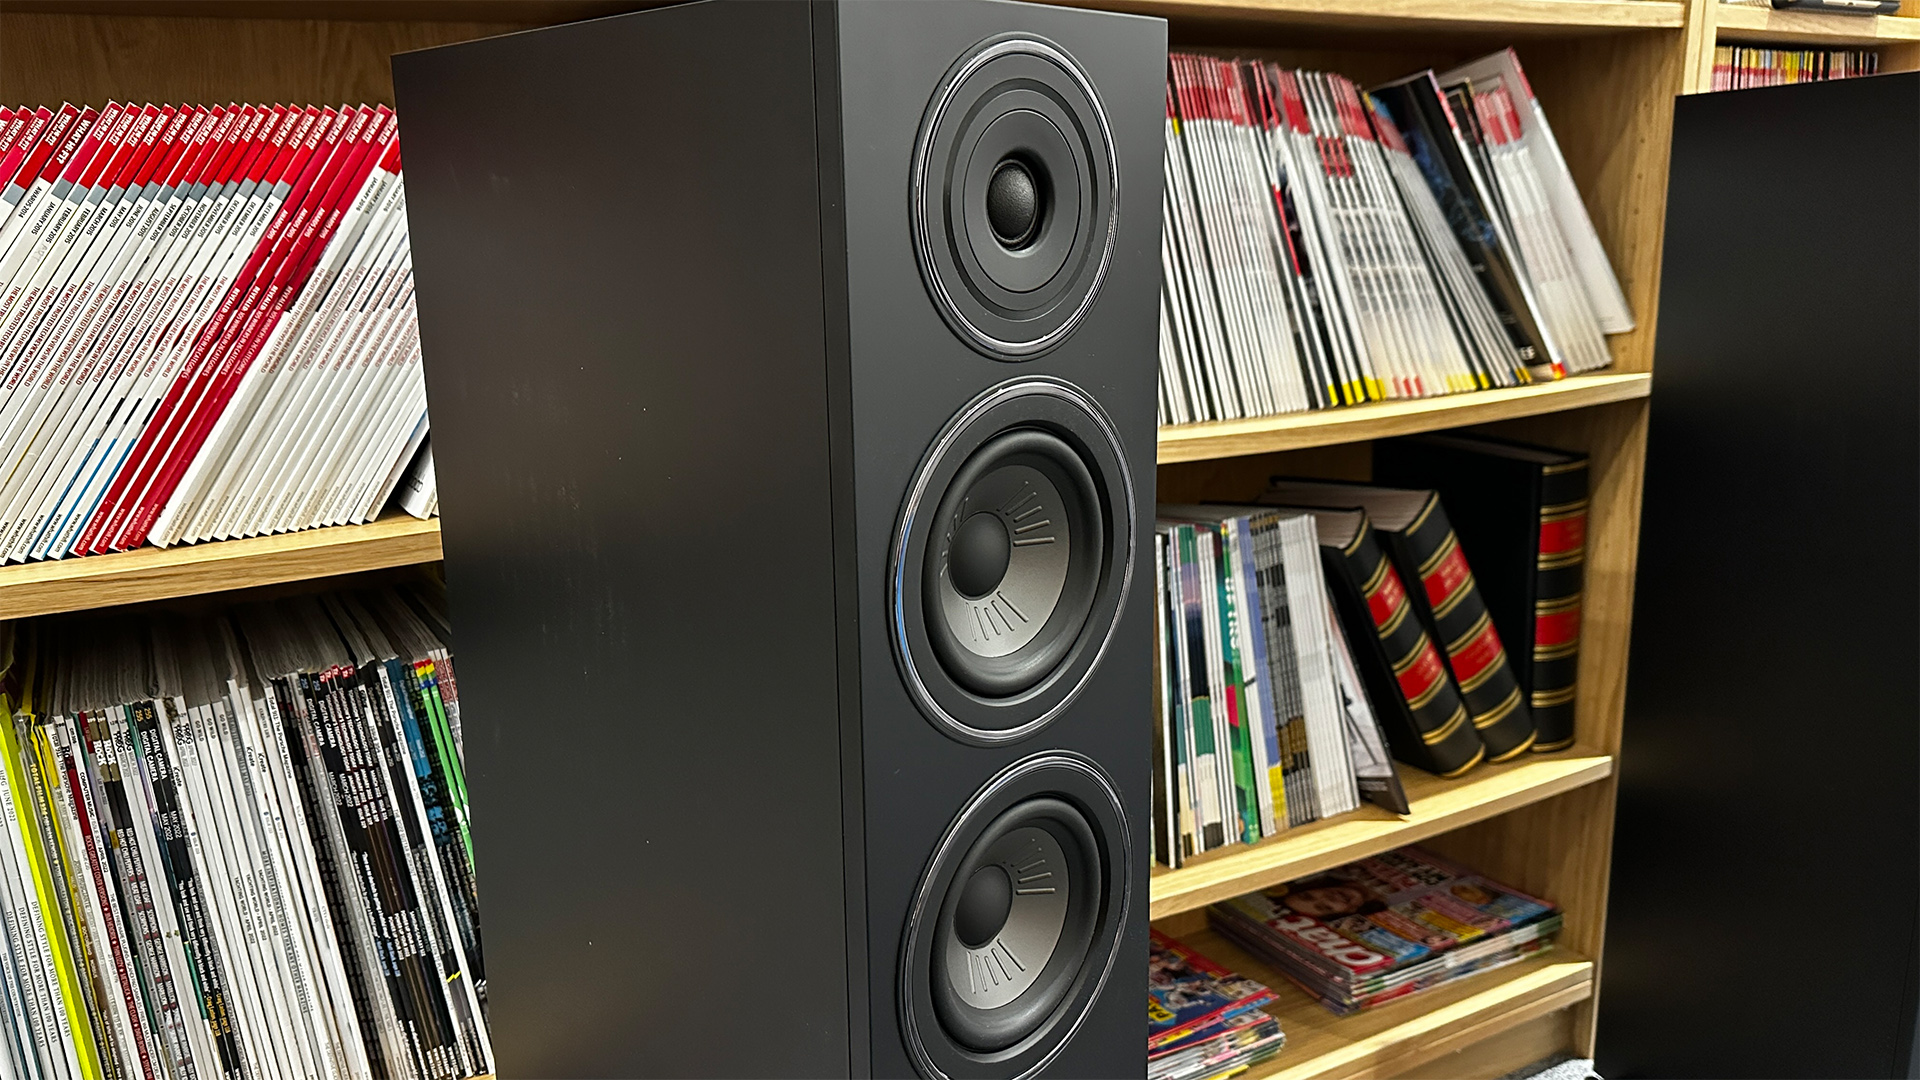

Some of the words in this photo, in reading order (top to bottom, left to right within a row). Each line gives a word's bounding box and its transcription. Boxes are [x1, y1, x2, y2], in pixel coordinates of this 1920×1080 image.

[69, 117, 91, 143] WHAT
[24, 185, 42, 207] AWARDS
[17, 205, 29, 218] 2014
[37, 200, 55, 224] JANUARY
[92, 206, 107, 225] MARCH
[115, 205, 126, 217] MAY
[131, 203, 143, 217] JUNE
[144, 206, 159, 226] AUGUST
[156, 202, 176, 230] SEPTEMBER
[175, 204, 192, 227] OCTOBER
[187, 203, 207, 229] NOVEMBER
[203, 201, 223, 228] NOVEMBER
[221, 199, 239, 224] DECEMBER
[237, 201, 256, 226] DECEMBER
[255, 201, 273, 226] DECEMBER
[272, 208, 288, 229] AWARDS
[292, 207, 308, 227] AWARDS
[310, 207, 325, 227] AWARDS
[51, 206, 71, 232] FEBRUARY
[70, 207, 90, 233] FEBRUARY
[109, 215, 120, 228] 2015
[125, 215, 135, 228] 2015
[30, 222, 42, 235] 2015
[45, 230, 56, 243] 2015
[85, 223, 97, 236] 2015
[137, 225, 148, 237] 2015
[149, 228, 160, 241] 2015
[168, 225, 179, 237] 2015
[181, 227, 191, 239] 2015
[197, 226, 207, 238] 2015
[214, 223, 224, 235] 2015
[231, 224, 241, 236] 2015
[249, 225, 259, 236] 2015
[266, 227, 276, 239] 2015
[286, 225, 296, 238] 2015
[303, 225, 314, 237] 2015
[63, 231, 75, 244] 2015
[134, 279, 144, 290] THE
[126, 288, 138, 303] MOST
[114, 302, 130, 323] TRUSTED
[106, 321, 118, 335] TECH
[94, 332, 110, 354] REVIEWS
[85, 357, 95, 369] THE
[74, 366, 89, 385] WORLD
[205, 717, 212, 726] GO
[218, 713, 225, 722] GO
[318, 700, 329, 722] DIGITAL
[324, 722, 336, 748] CAMERA
[208, 726, 216, 739] WILD
[139, 731, 151, 754] DIGITAL
[146, 755, 158, 781] CAMERA
[148, 728, 160, 752] DIGITAL
[155, 752, 167, 779] CAMERA
[79, 772, 90, 800] COMPUTER
[86, 800, 94, 817] MUSIC
[338, 773, 349, 793] MARCH
[344, 793, 353, 807] 2022
[2, 789, 11, 806] JUNE
[7, 808, 15, 822] 2022
[160, 813, 169, 825] MAY
[169, 810, 178, 823] MAY
[163, 825, 173, 841] 2022
[172, 823, 182, 838] 2022
[97, 846, 105, 860] APRIL
[256, 869, 267, 891] YACHTING
[262, 891, 271, 908] WORLD
[18, 906, 31, 938] DEFINING
[30, 900, 44, 932] DEFINING
[267, 910, 276, 924] APRIL
[271, 924, 279, 936] 2022
[26, 939, 36, 959] STYLE
[39, 933, 49, 952] STYLE
[31, 959, 40, 973] FOR
[44, 954, 53, 967] FOR
[35, 974, 44, 992] MORE
[48, 968, 57, 986] MORE
[40, 993, 49, 1011] THAN
[53, 987, 62, 1005] THAN
[44, 1012, 52, 1022] 100
[47, 1023, 57, 1043] YEARS
[61, 1017, 71, 1037] YEARS
